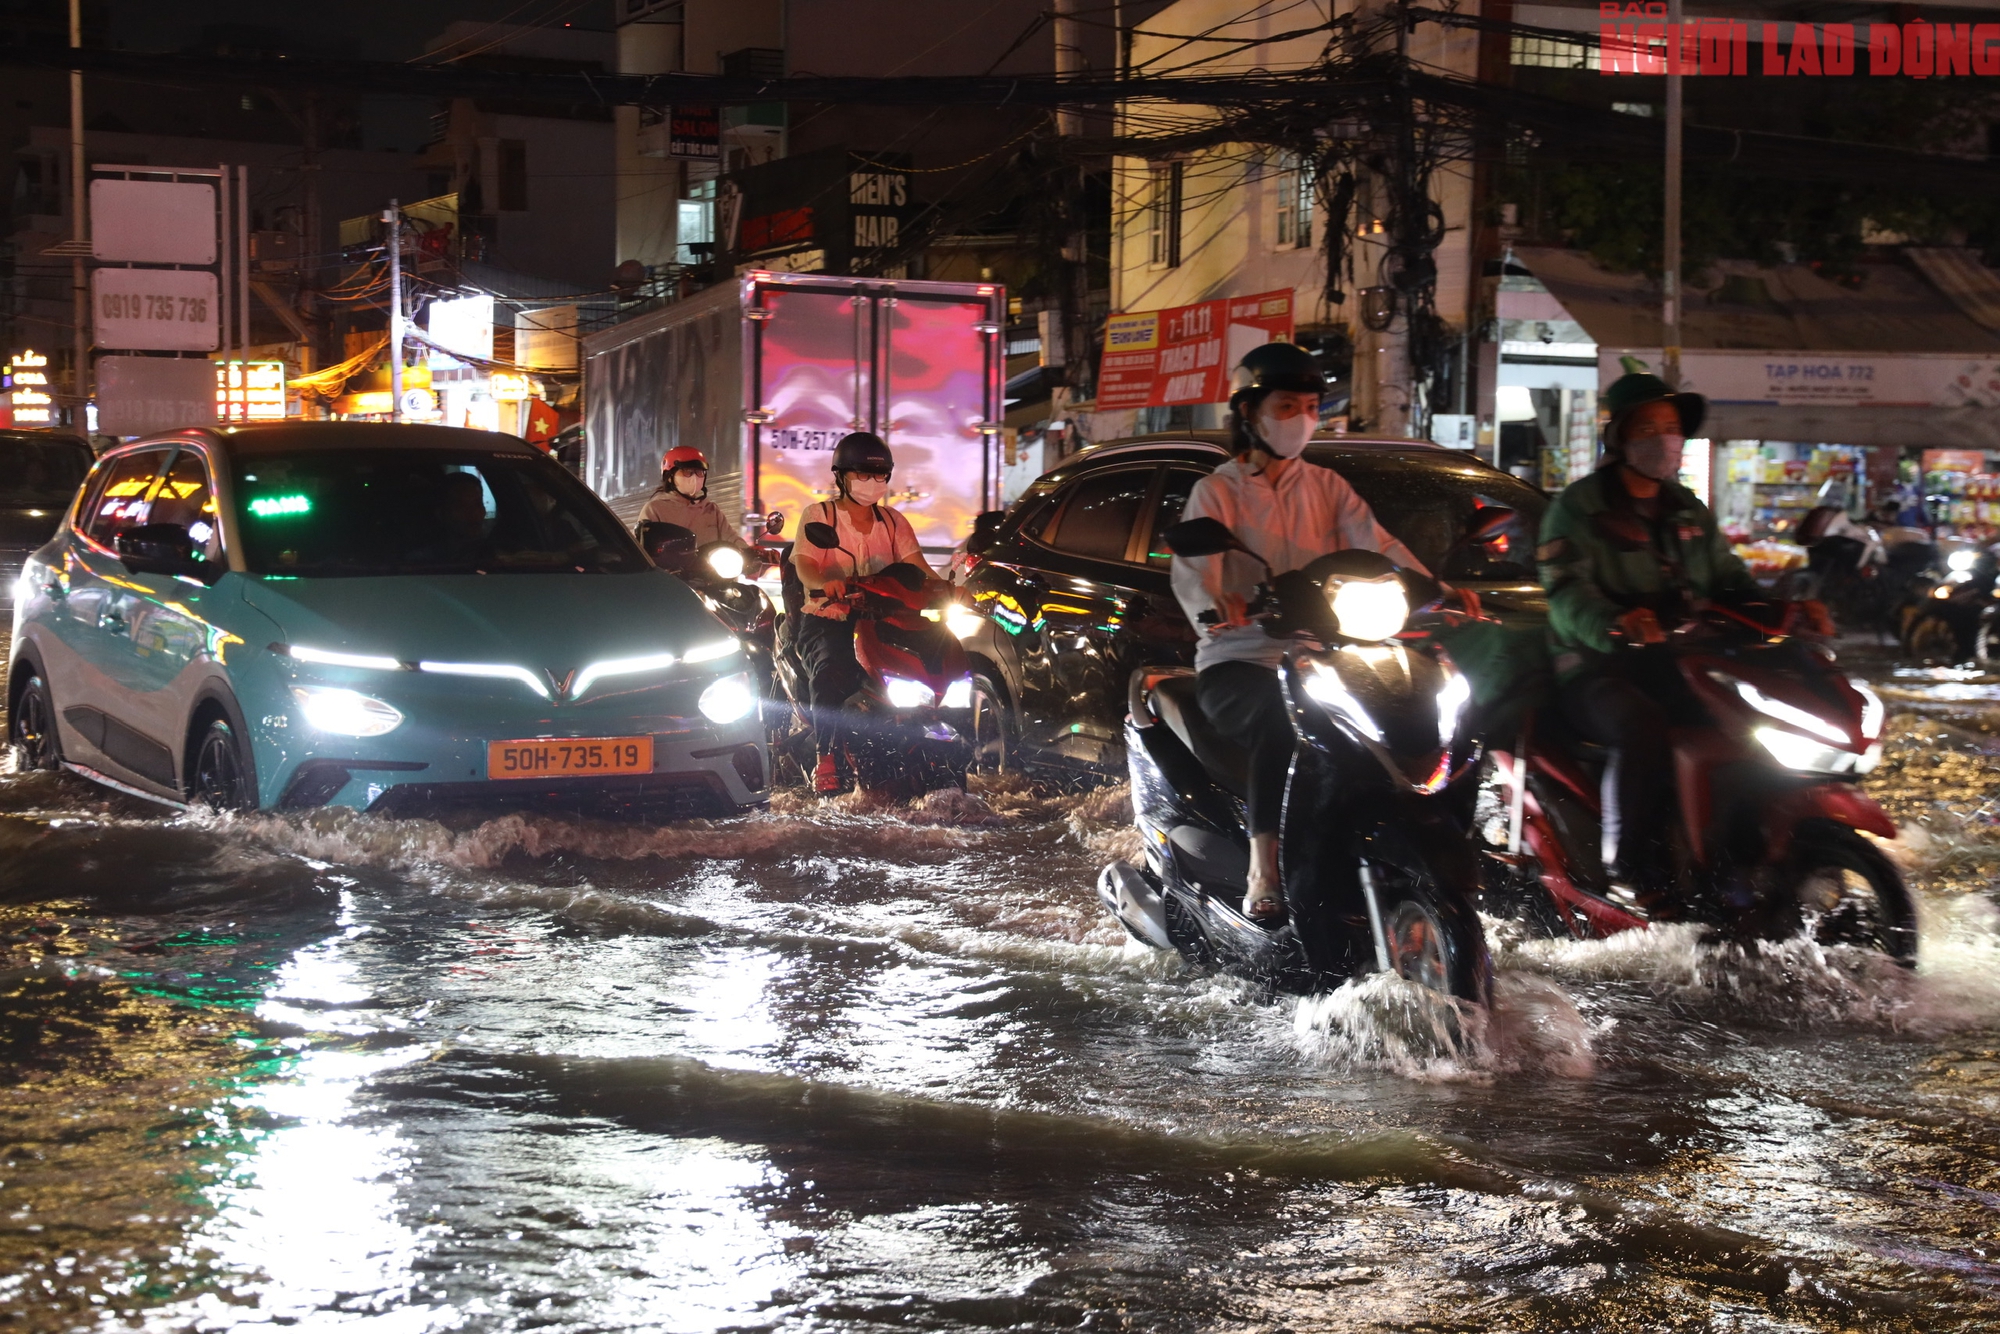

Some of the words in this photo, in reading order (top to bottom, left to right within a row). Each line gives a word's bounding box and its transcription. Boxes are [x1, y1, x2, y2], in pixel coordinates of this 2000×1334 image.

[850, 173, 907, 207] MEN'S
[102, 293, 142, 319] 0919
[145, 295, 174, 321] 735
[179, 297, 207, 323] 736
[771, 429, 846, 451] 50H-257.2
[503, 744, 638, 771] 50H-735.19
